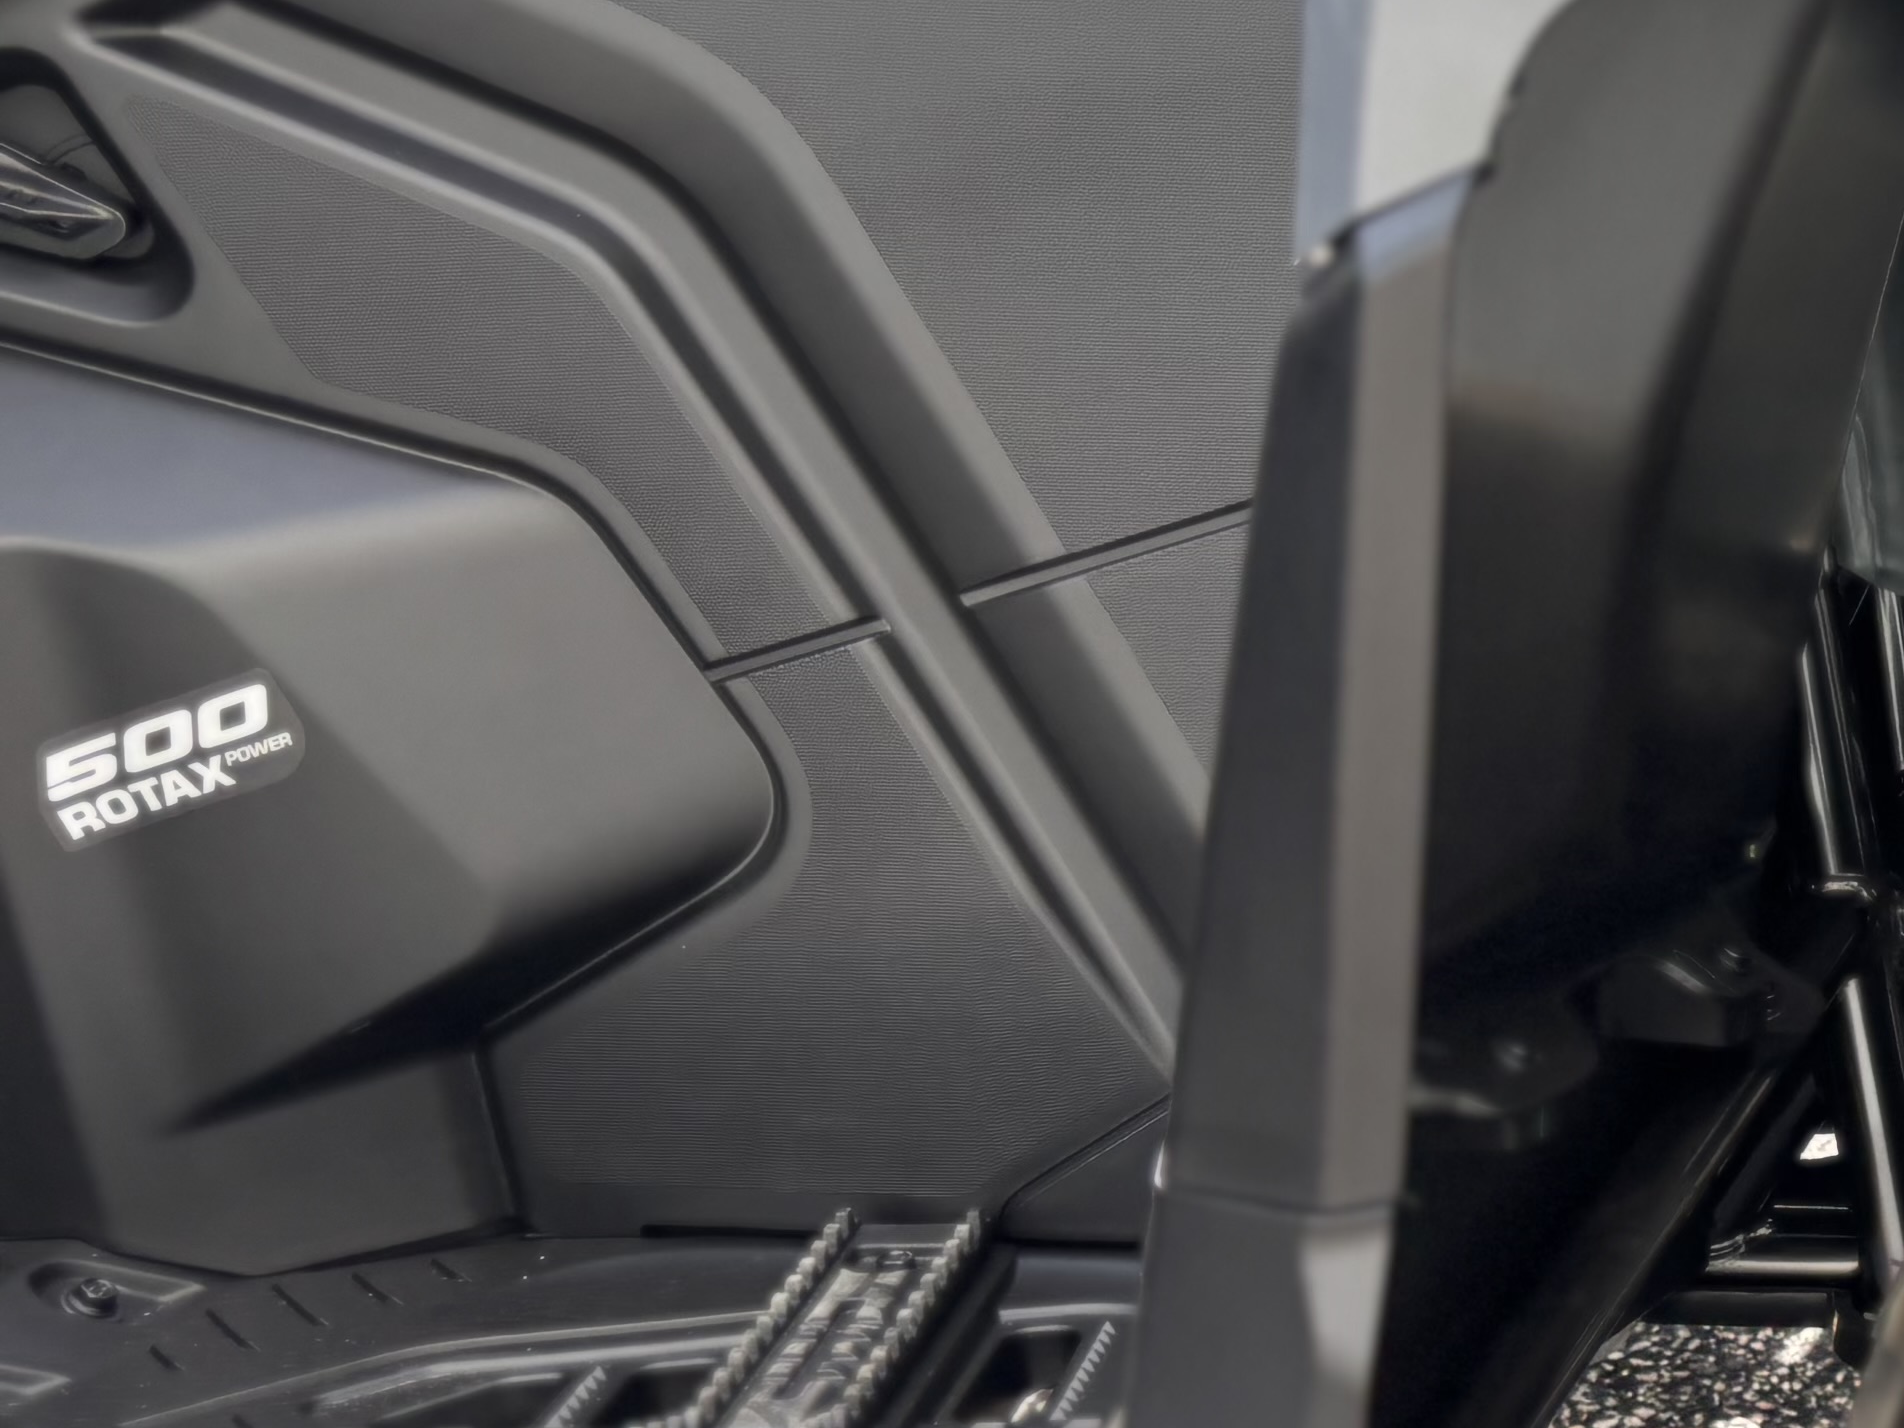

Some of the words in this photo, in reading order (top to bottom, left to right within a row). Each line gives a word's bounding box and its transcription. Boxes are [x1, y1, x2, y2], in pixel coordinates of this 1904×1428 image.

[46, 683, 268, 802] 500
[57, 755, 237, 841] ROTAX
[224, 731, 293, 767] POWER
